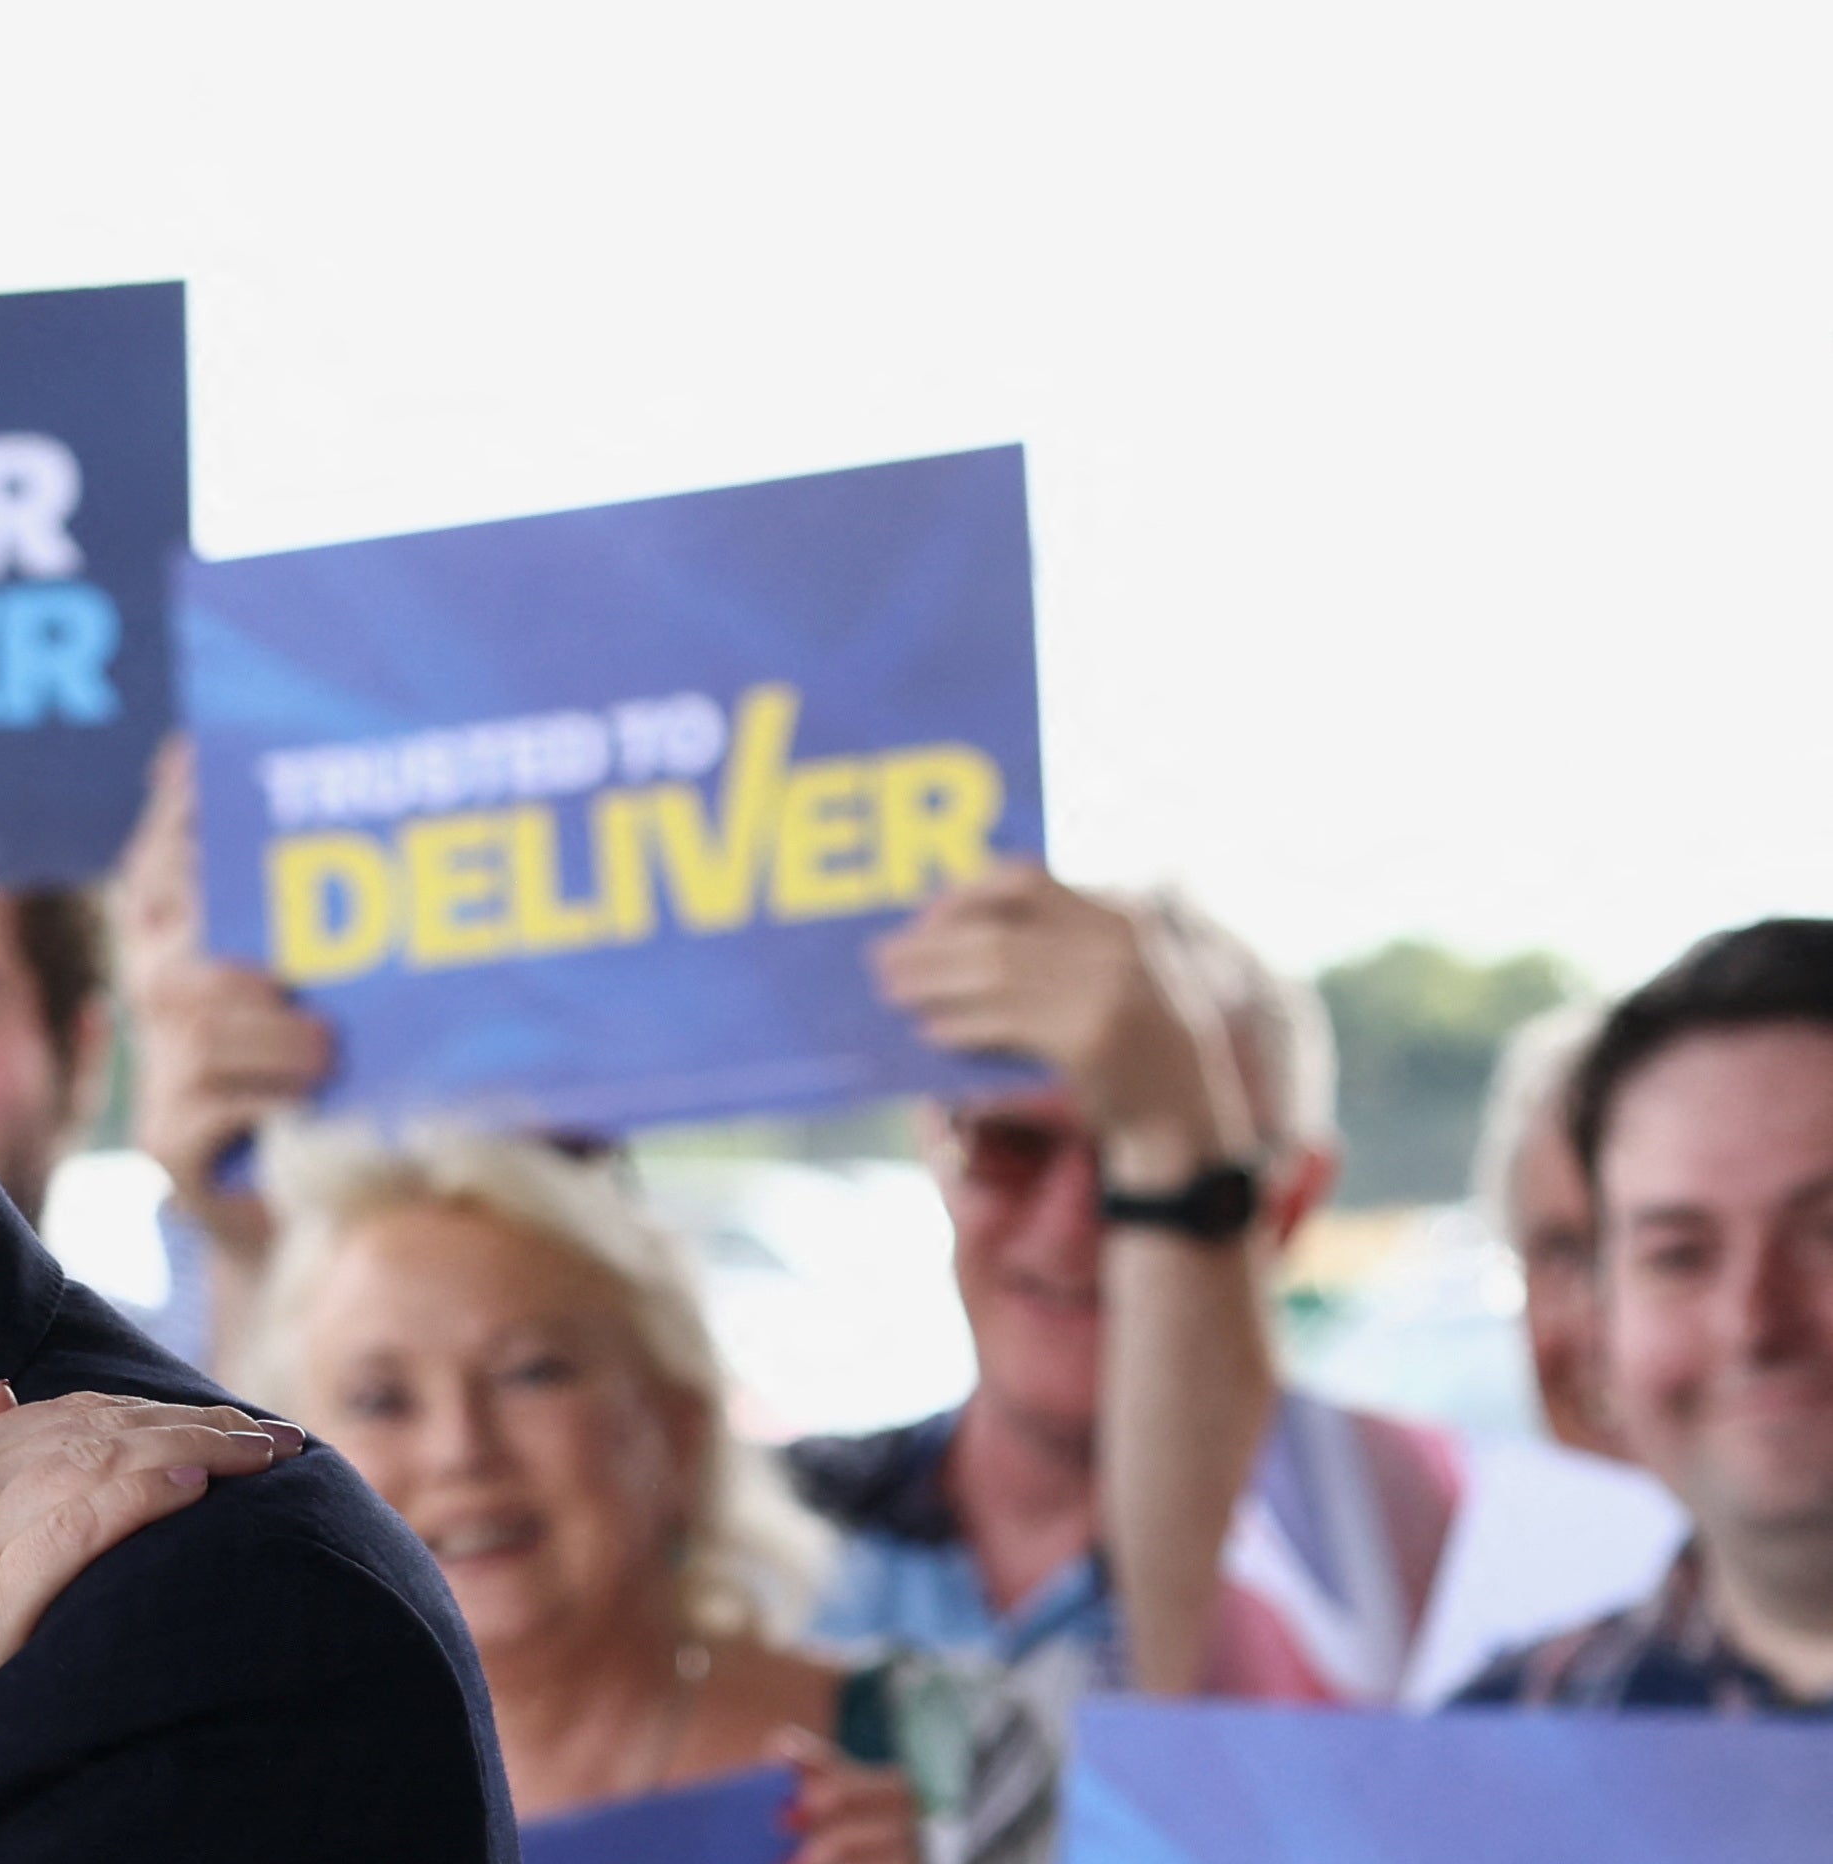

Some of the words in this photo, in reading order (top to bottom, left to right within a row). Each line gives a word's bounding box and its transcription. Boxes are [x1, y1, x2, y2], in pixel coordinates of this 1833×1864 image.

[256, 709, 608, 824] TRUSTED
[614, 692, 725, 784] TO
[267, 682, 1003, 983] DELIVER
